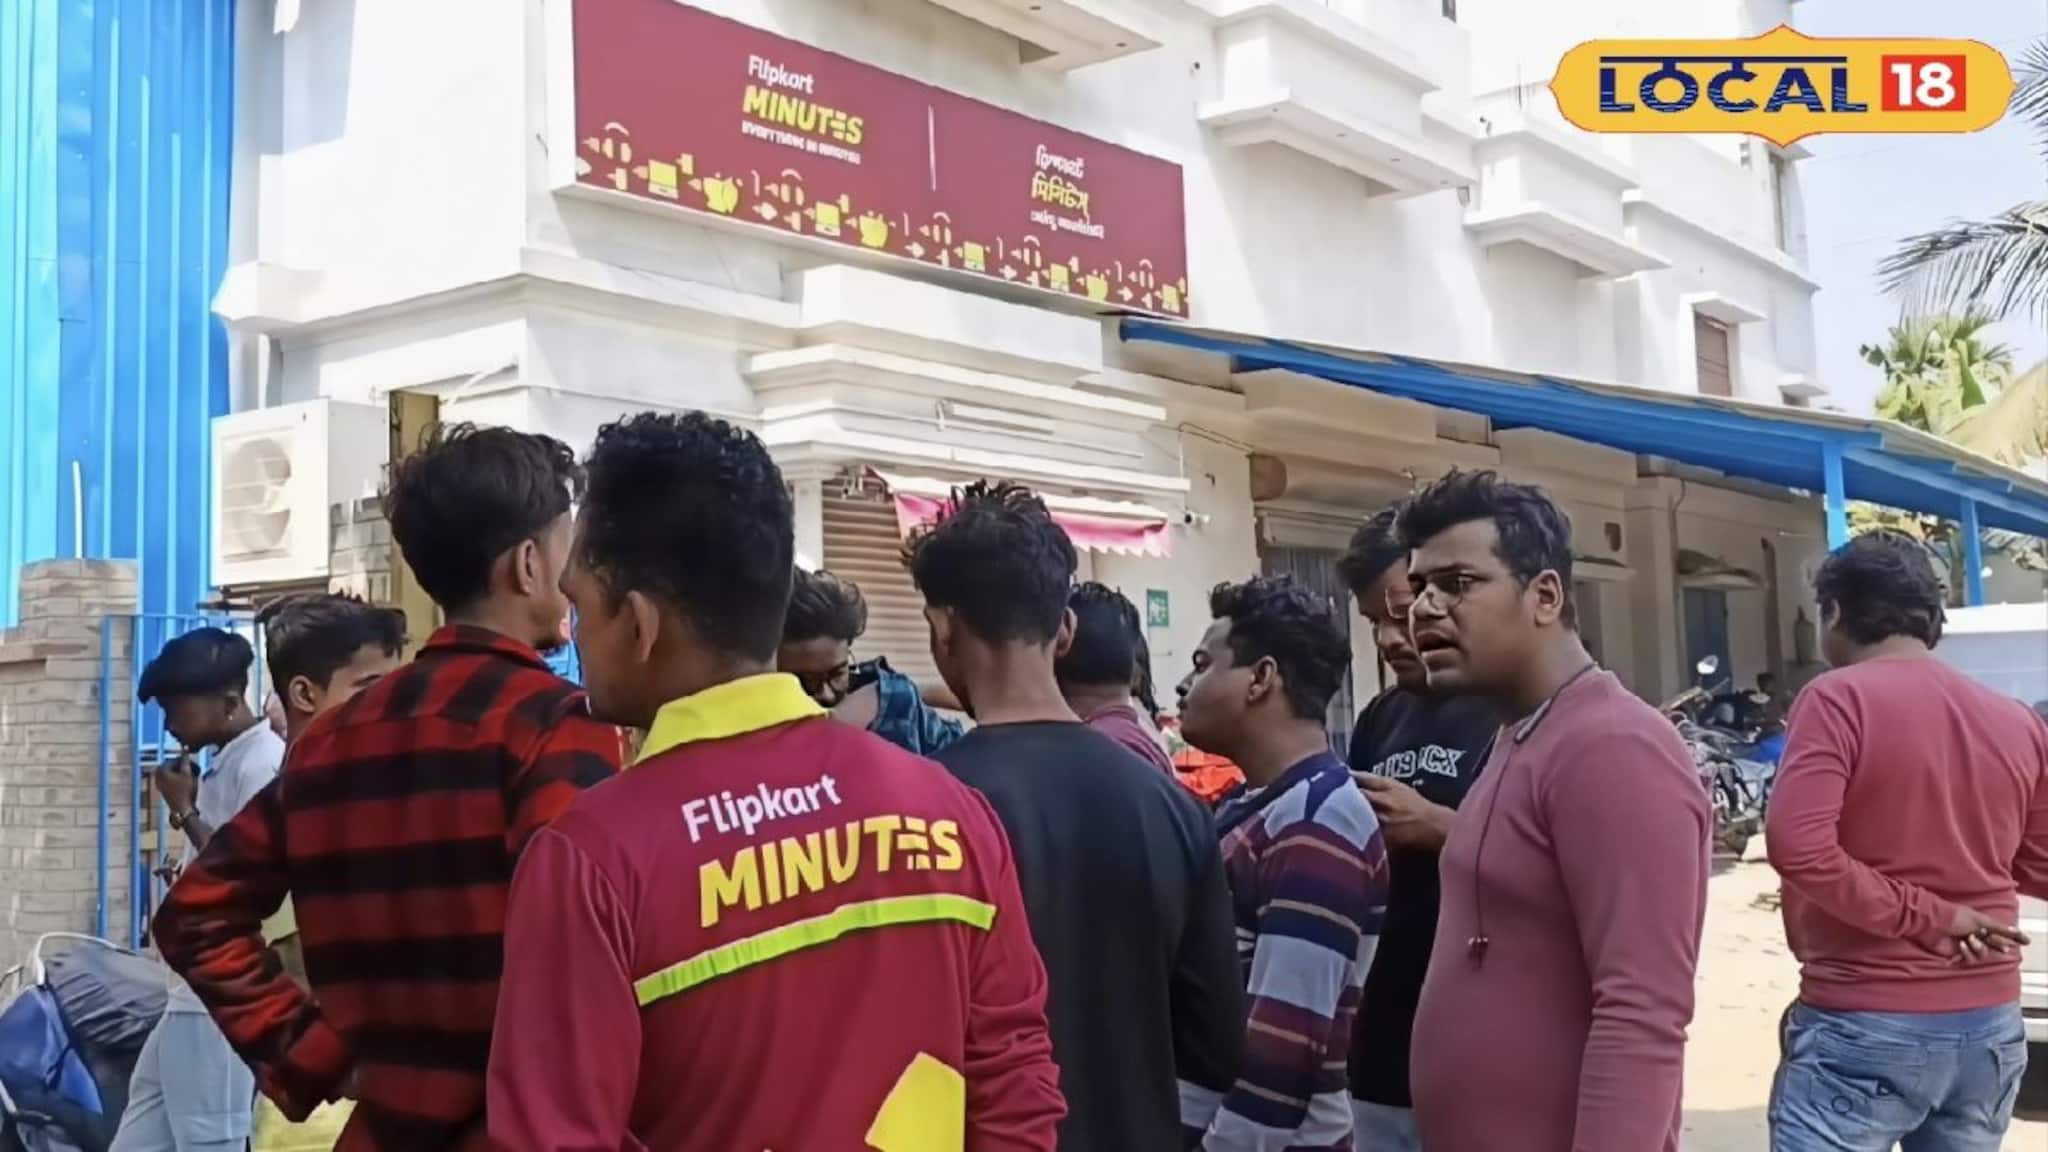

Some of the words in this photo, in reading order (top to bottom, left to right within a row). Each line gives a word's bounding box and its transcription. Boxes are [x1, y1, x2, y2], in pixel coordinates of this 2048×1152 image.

[748, 54, 814, 94] Flipkart
[743, 85, 864, 145] MINUTES
[681, 774, 842, 843] Flipkart
[699, 815, 964, 928] MINUTES
